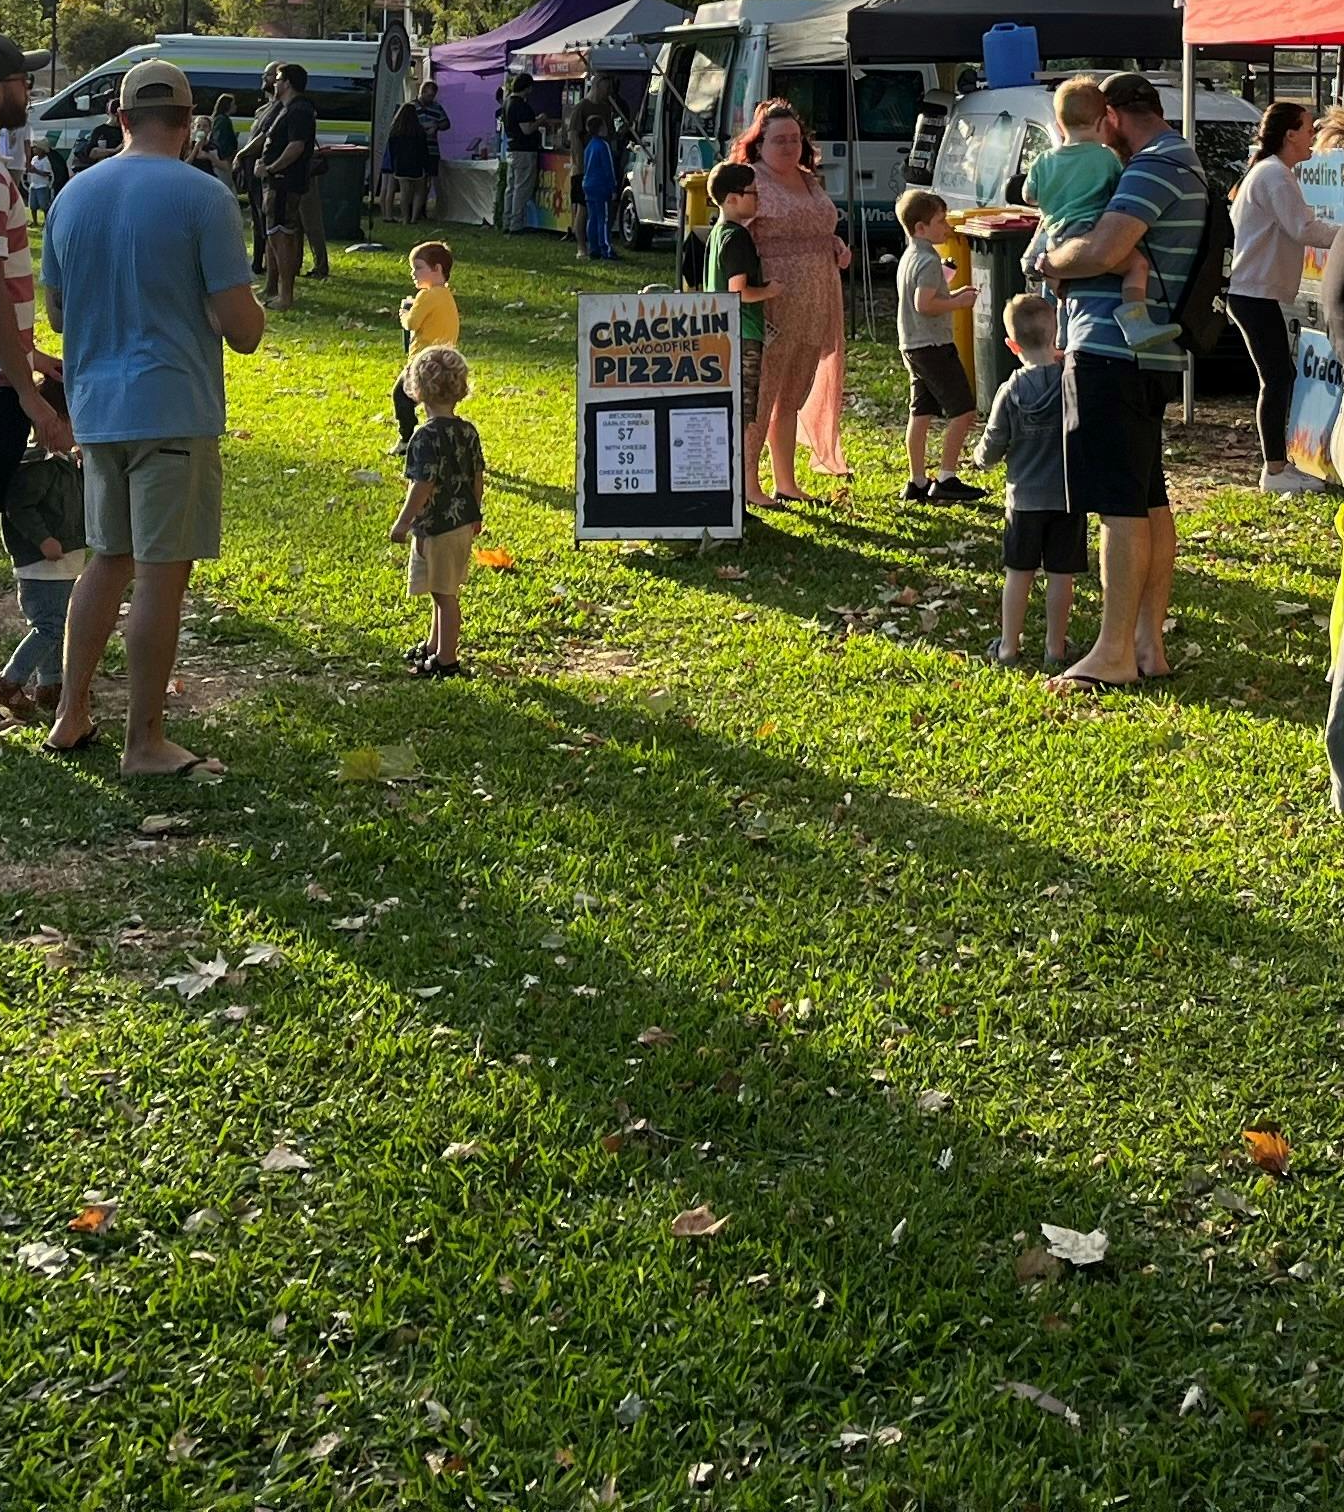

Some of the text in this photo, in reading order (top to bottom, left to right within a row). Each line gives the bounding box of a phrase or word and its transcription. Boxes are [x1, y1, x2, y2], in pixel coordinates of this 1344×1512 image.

[862, 207, 896, 222] Whe
[589, 311, 729, 349] CRACKLIN
[629, 340, 701, 355] WOODFIRE
[594, 355, 724, 384] PIZZAS
[1303, 344, 1344, 386] Crack
[617, 427, 634, 442] $7
[617, 451, 635, 465] $9
[613, 476, 639, 491] $10
